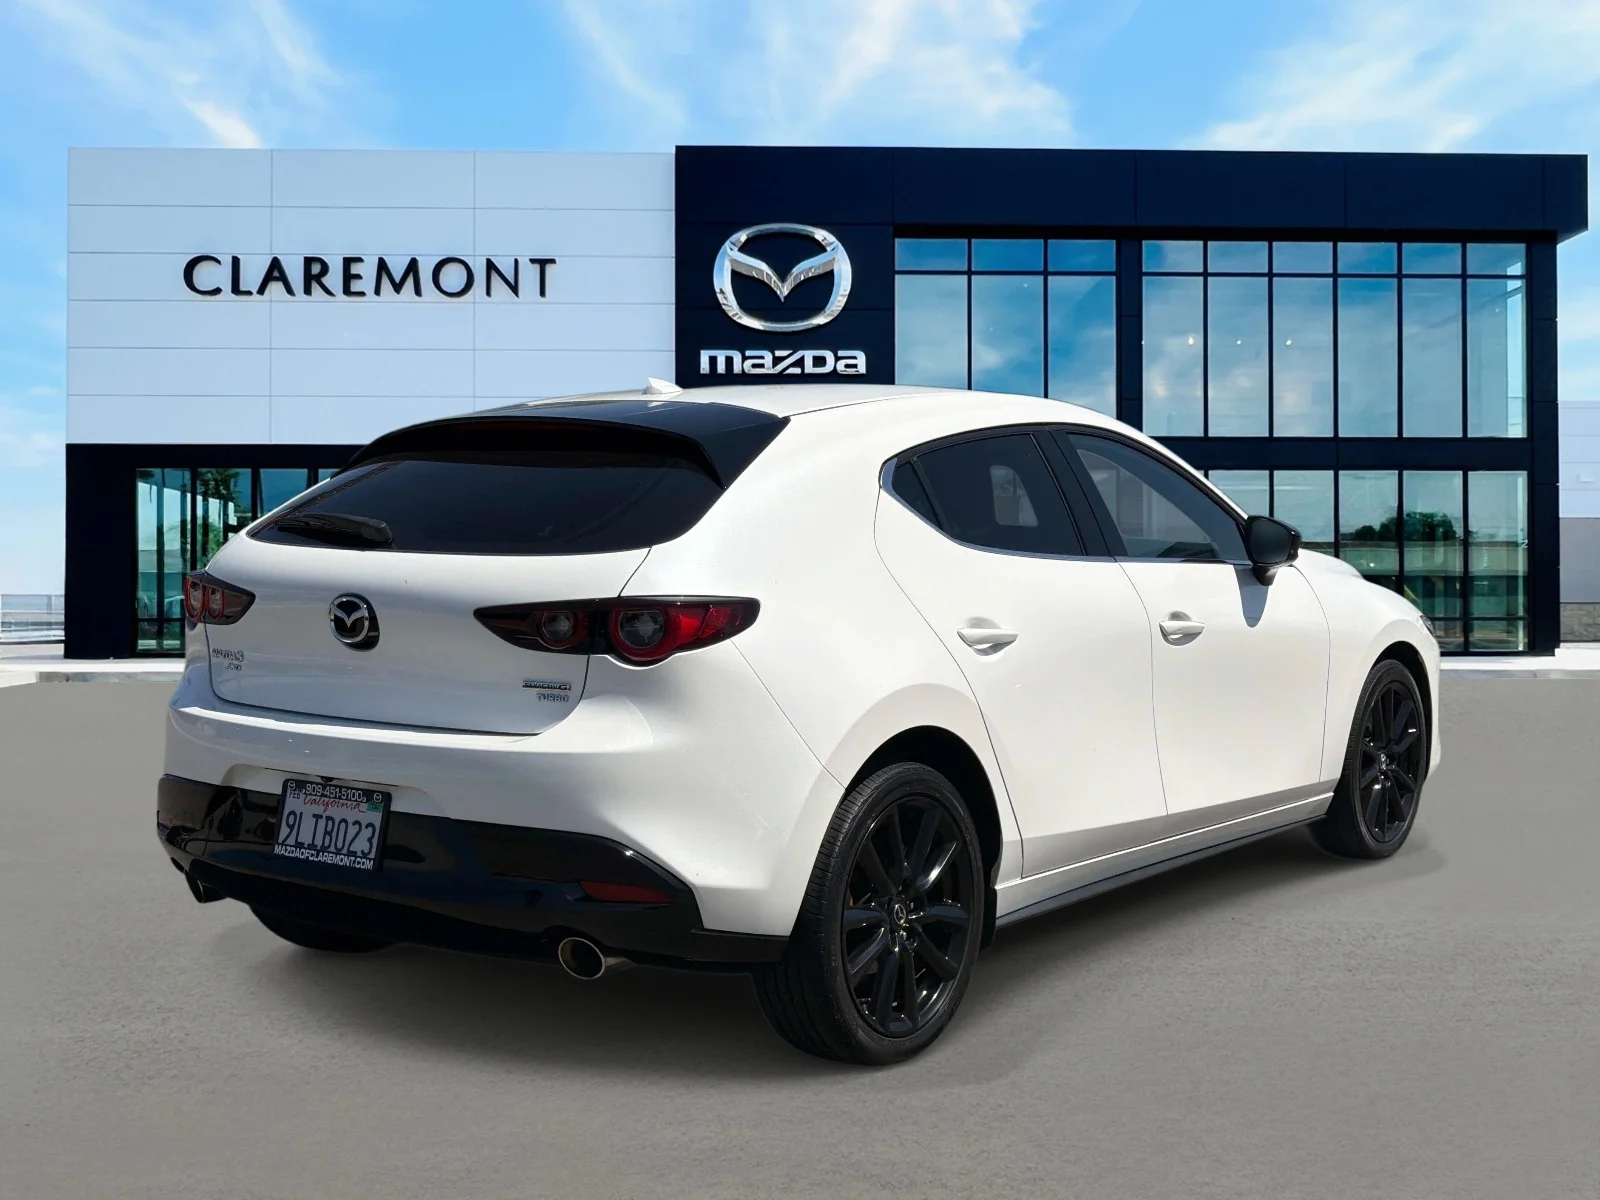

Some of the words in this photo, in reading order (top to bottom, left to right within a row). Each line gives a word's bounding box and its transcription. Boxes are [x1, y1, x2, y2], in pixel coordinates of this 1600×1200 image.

[183, 254, 557, 299] CLAREMONT
[700, 349, 867, 376] mazda
[536, 693, 569, 702] TURBO
[303, 795, 367, 813] California
[305, 784, 363, 802] 909-451-5100
[281, 810, 376, 857] 9LIB023
[274, 845, 374, 870] MAZDAOFCLAREMONT.COM
